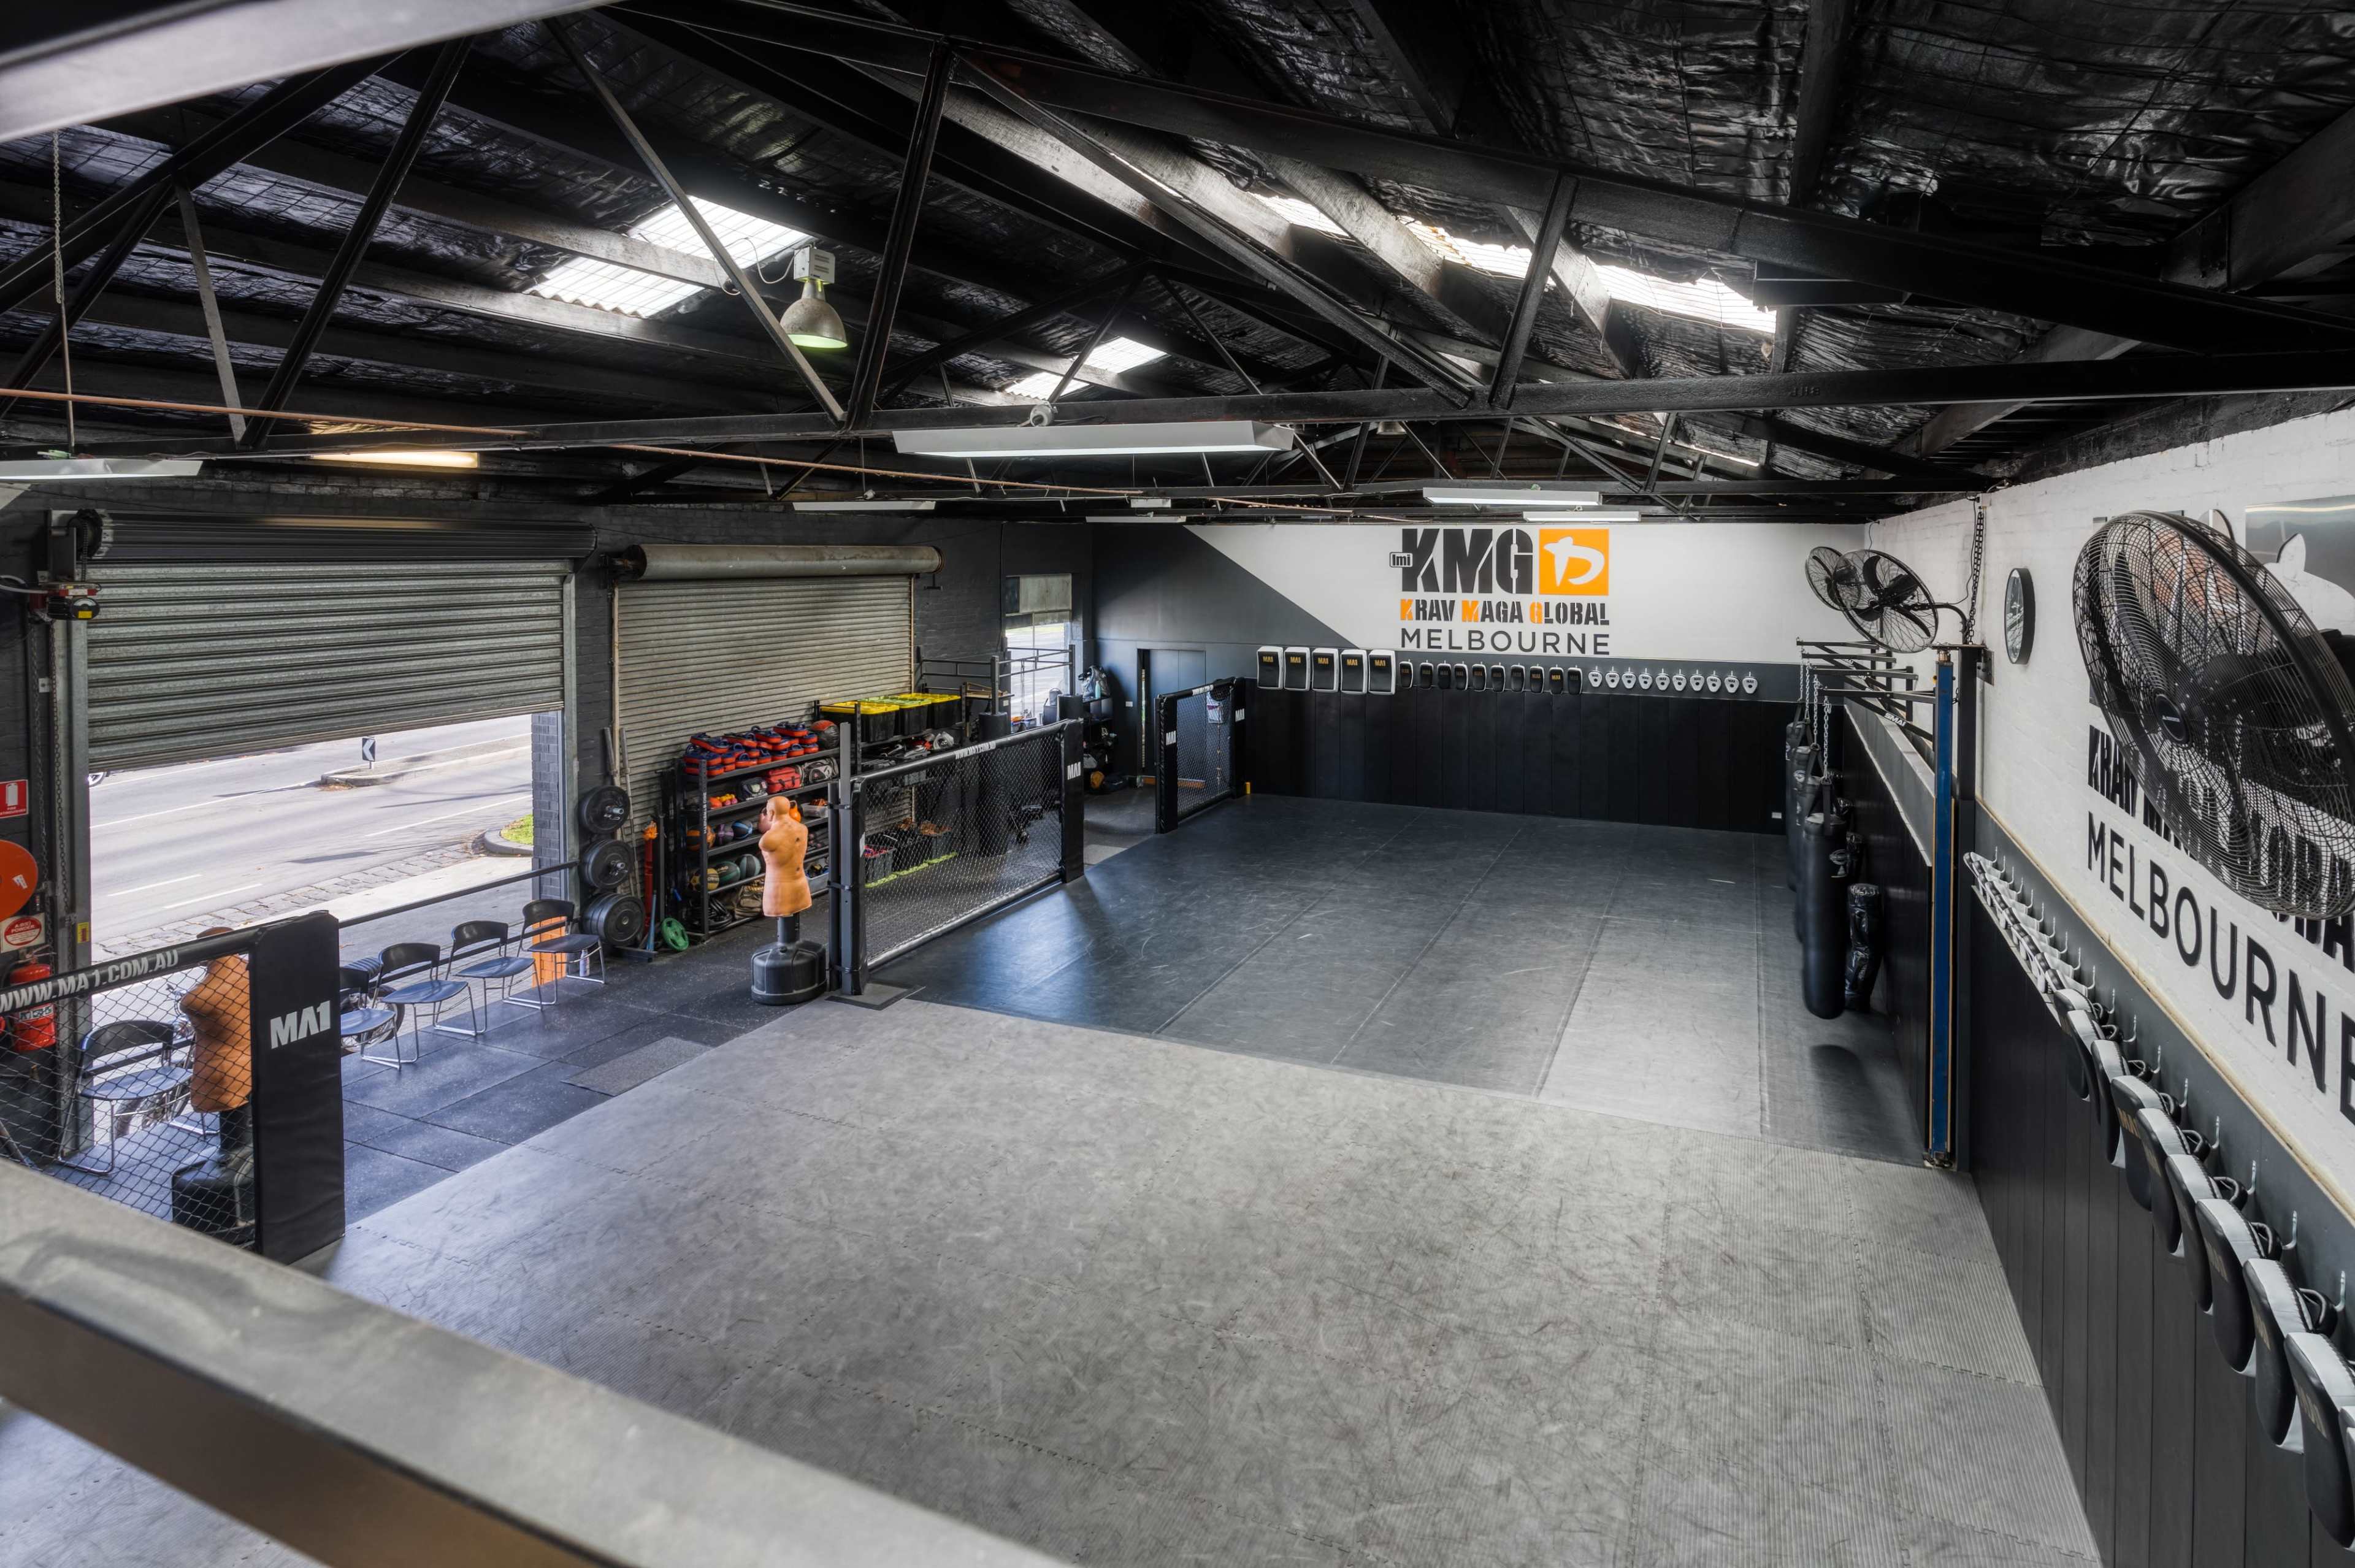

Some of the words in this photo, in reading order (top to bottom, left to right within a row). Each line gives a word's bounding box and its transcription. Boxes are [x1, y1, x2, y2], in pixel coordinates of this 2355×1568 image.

[1402, 529, 1533, 594] KMG
[1400, 599, 1455, 622] KRAV
[1462, 600, 1523, 624] MAGA
[1530, 602, 1610, 625] GLOBAL
[1401, 628, 1610, 655] MELBOURNE
[270, 1001, 331, 1049] MA1
